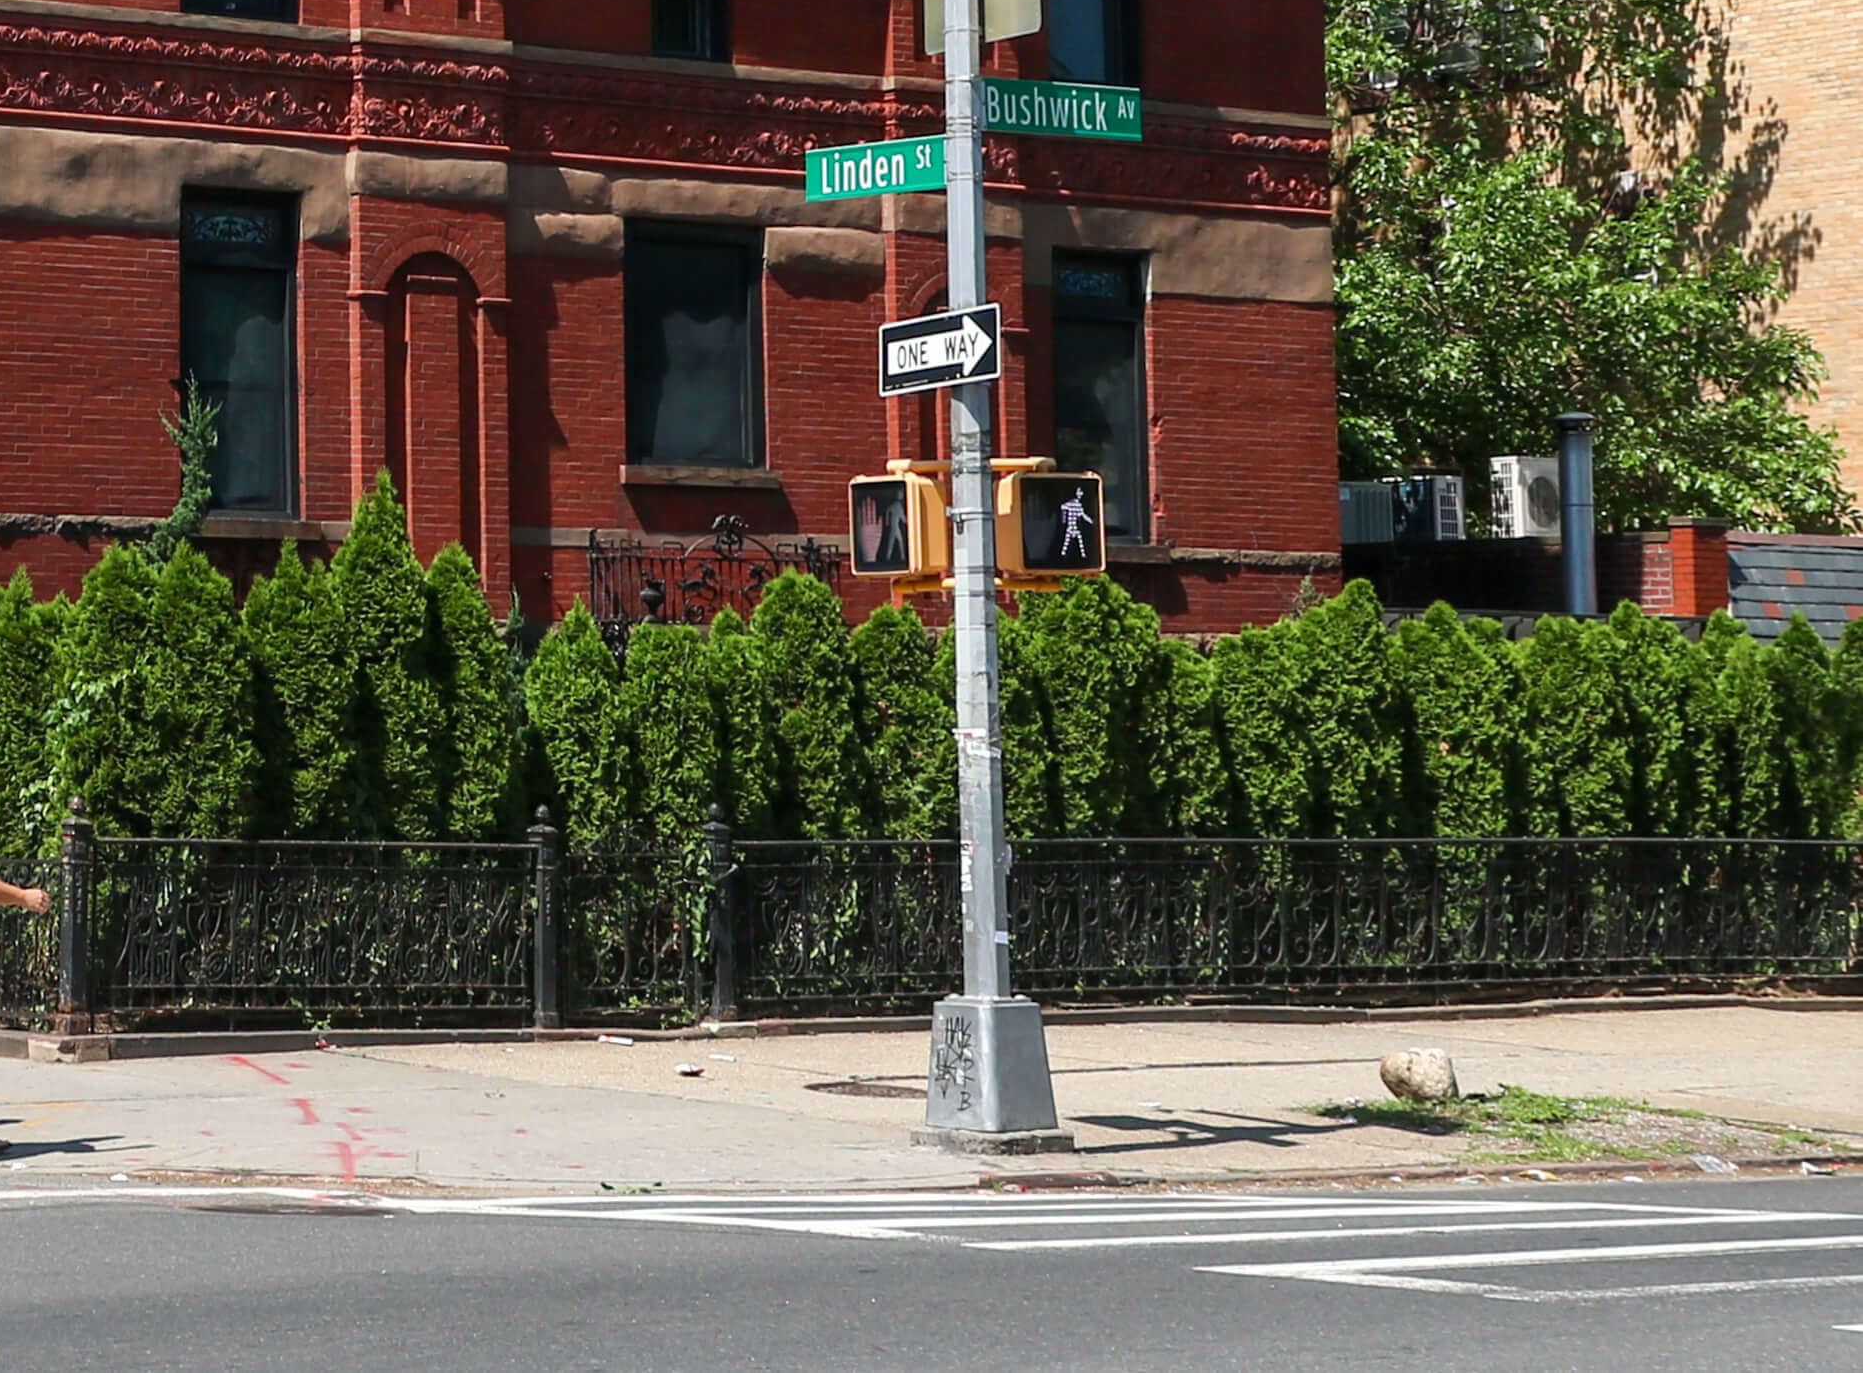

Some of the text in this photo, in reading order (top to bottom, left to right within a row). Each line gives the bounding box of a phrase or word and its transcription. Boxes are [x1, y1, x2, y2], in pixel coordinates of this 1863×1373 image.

[987, 85, 1135, 132] Bushwick Av
[821, 143, 932, 195] Linden St
[897, 331, 979, 370] ONE WAY
